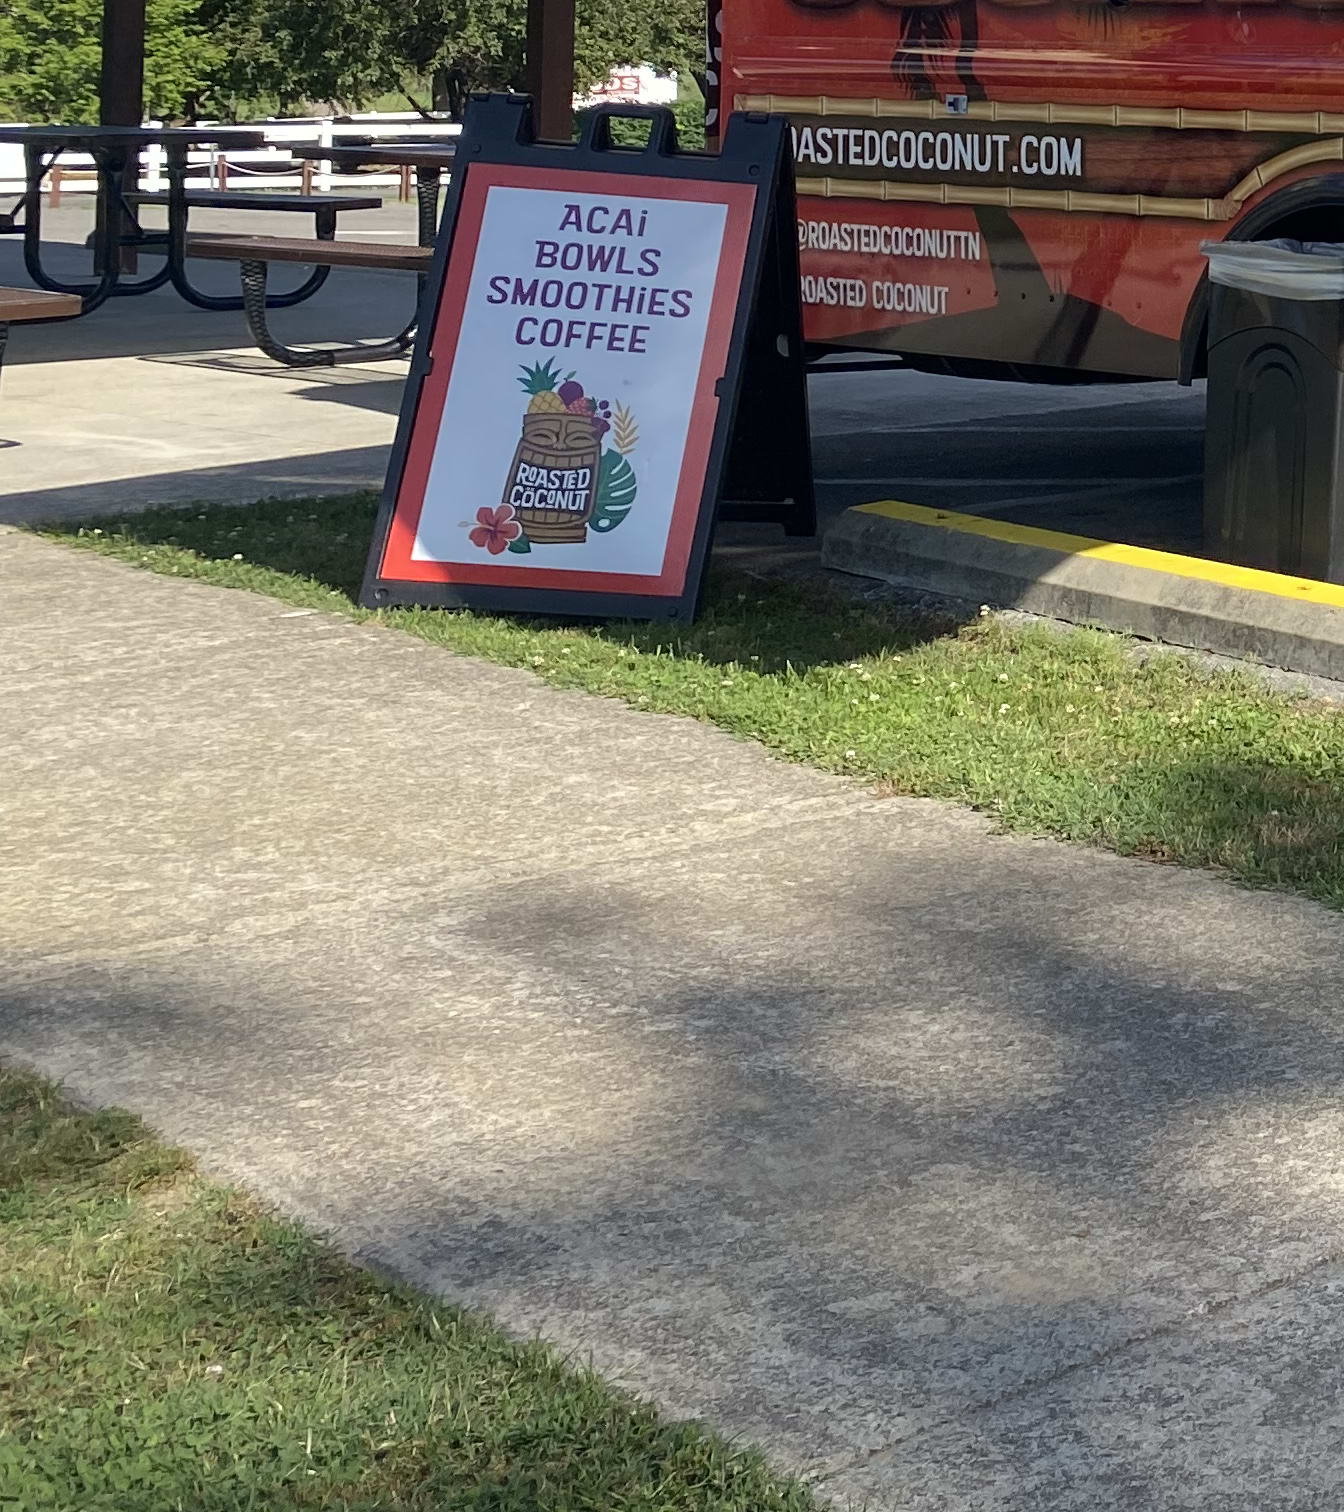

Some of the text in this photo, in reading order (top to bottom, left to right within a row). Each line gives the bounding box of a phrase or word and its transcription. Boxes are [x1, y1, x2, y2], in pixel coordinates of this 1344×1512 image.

[535, 240, 661, 277] BOWLS
[872, 282, 949, 314] COCONUT
[515, 317, 650, 354] COFFEE
[516, 462, 591, 489] ROASTED
